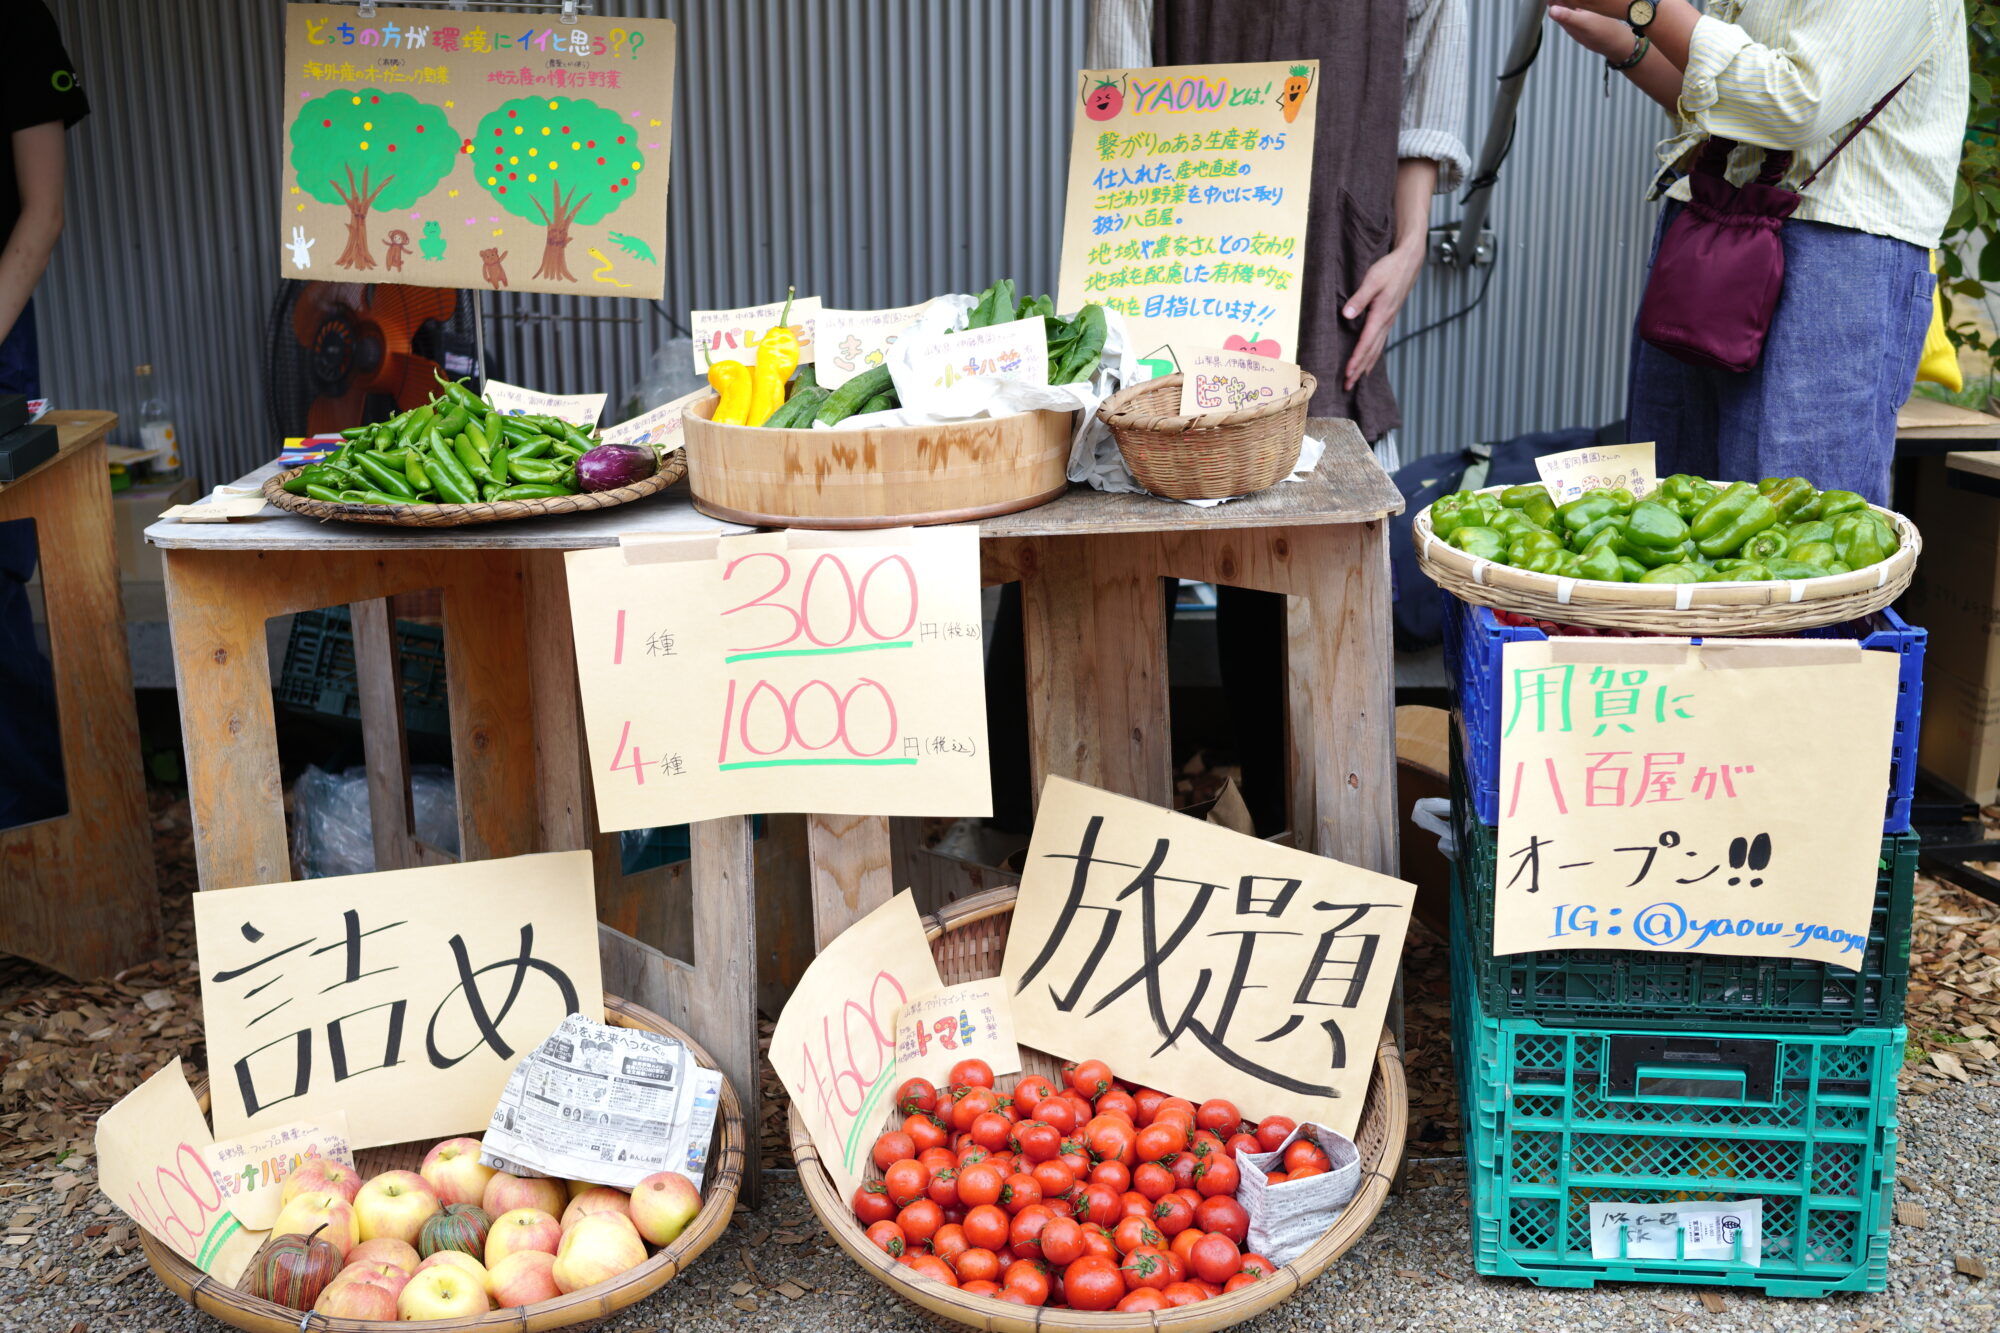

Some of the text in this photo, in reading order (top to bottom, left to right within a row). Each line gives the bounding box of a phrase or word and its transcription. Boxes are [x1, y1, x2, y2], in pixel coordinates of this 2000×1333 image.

[1096, 128, 1288, 161] 繋がりのある生産者から
[1093, 184, 1285, 211] こだわり野菜を中心に取り
[1503, 664, 1696, 738] 用賀に
[609, 720, 687, 786] 4種
[1507, 751, 1756, 818] 八百屋が
[1013, 815, 1404, 1099] 放題
[211, 908, 580, 1118] 詰め
[916, 1008, 977, 1057] トマト
